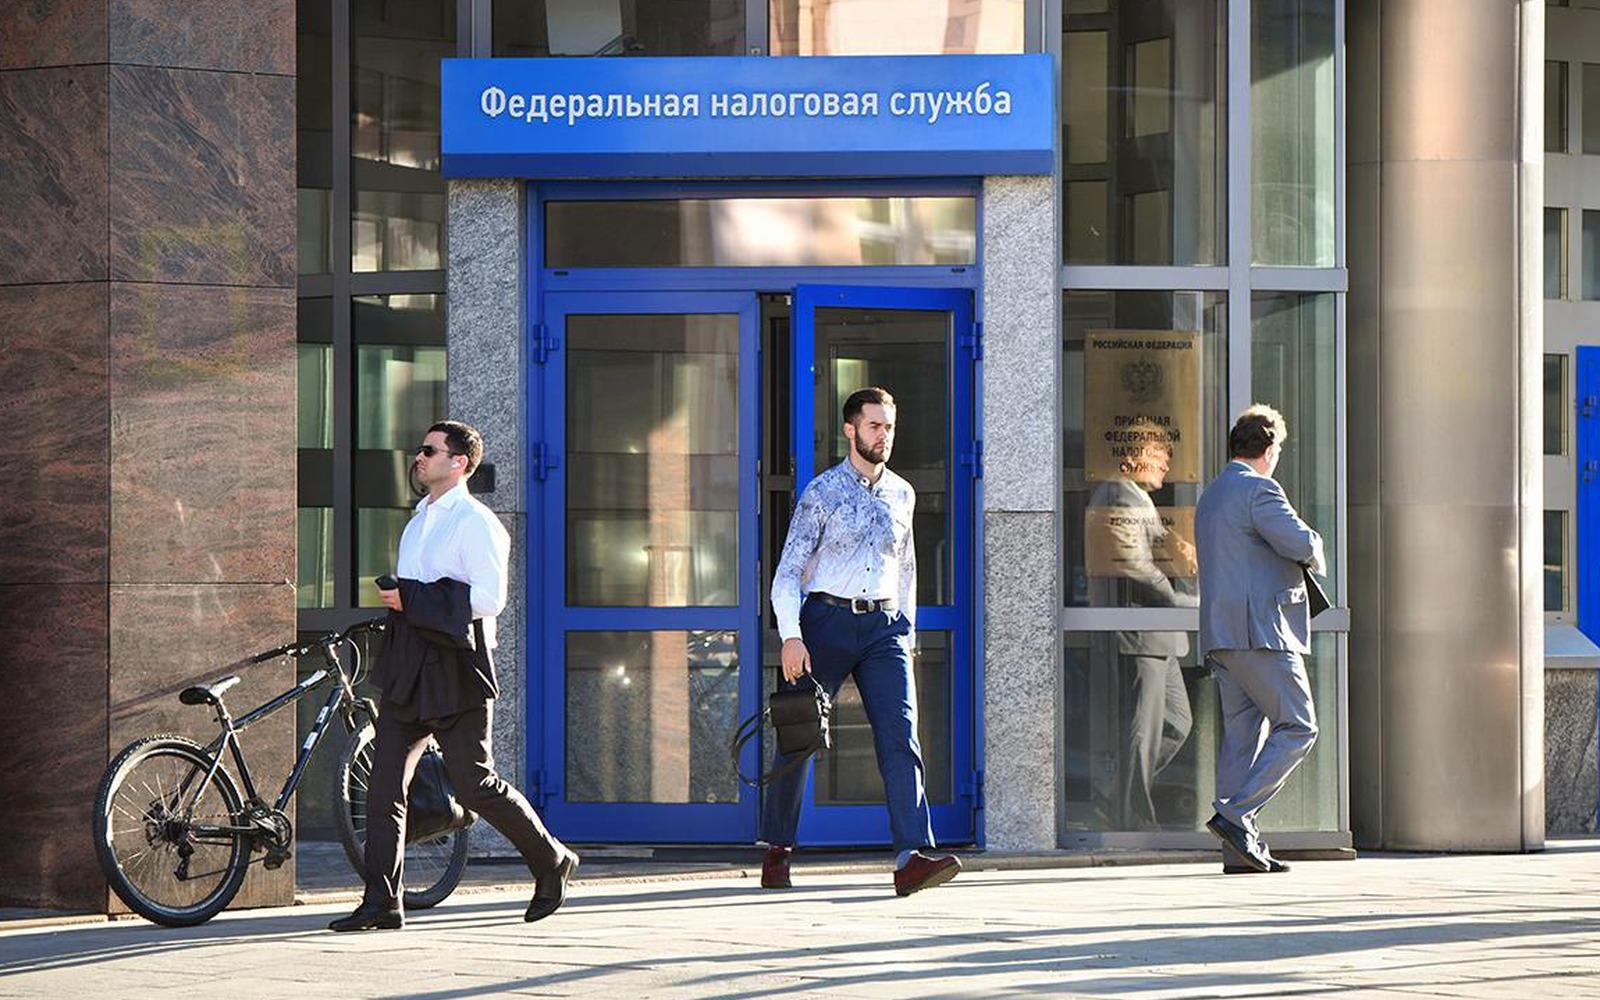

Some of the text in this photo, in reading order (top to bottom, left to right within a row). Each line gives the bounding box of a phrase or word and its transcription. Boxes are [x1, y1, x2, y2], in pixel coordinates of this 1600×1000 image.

[480, 82, 1012, 125] Федеральная налоговая служба
[1093, 339, 1193, 350] РОССИЙСКАЯ ФЕДЕРАЦИЯ
[1104, 429, 1181, 442] ФЕДЕРАЛЬНОЙ
